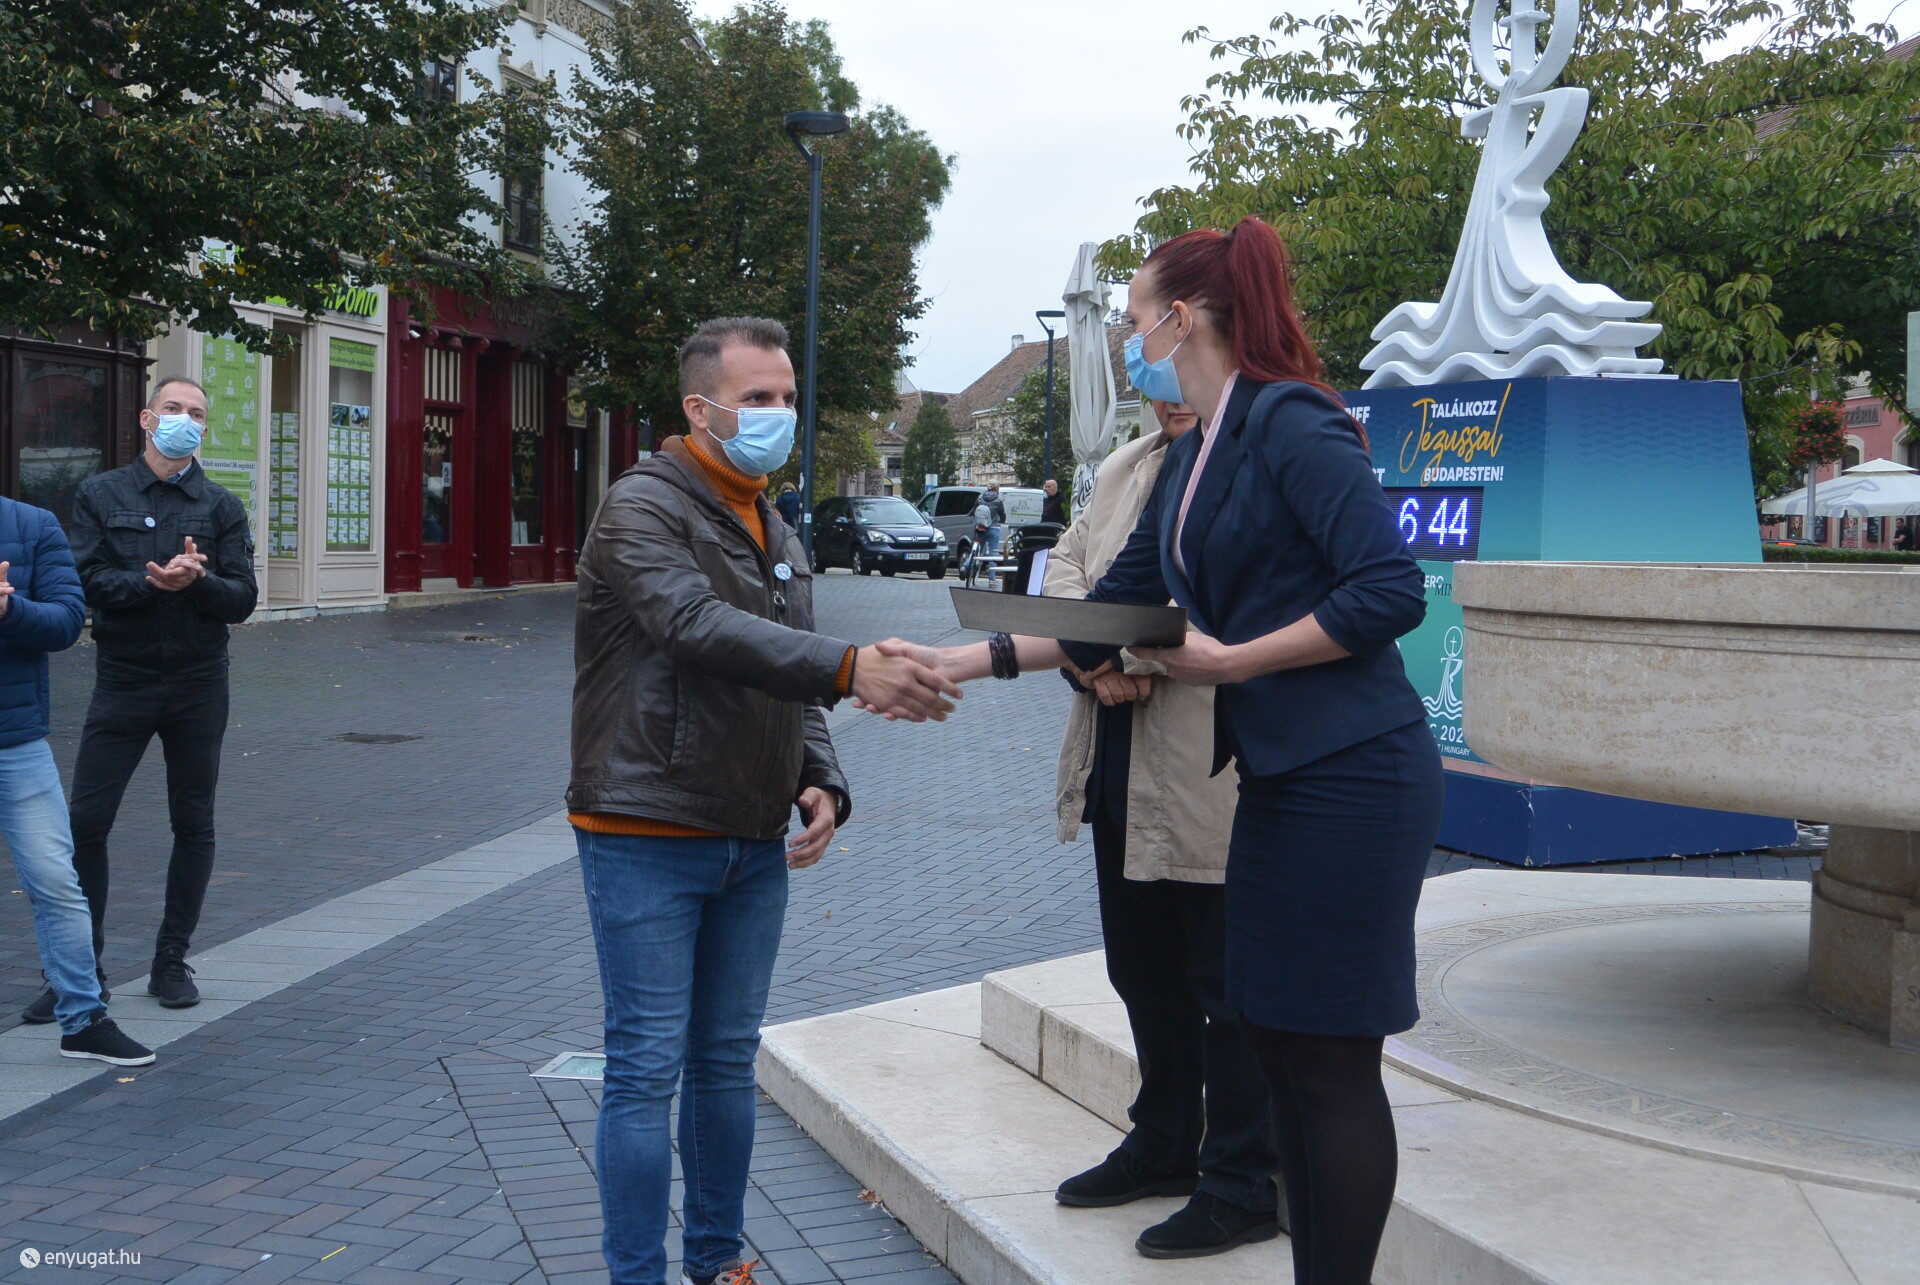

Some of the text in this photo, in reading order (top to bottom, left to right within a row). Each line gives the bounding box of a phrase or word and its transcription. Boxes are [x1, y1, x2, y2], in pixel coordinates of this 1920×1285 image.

[1430, 398, 1498, 418] TALÁLKOZZ
[1400, 382, 1512, 486] Jézussal
[1423, 466, 1504, 483] BUDAPESTEN!
[1428, 497, 1469, 545] 44
[1444, 746, 1471, 756] HUNGARY
